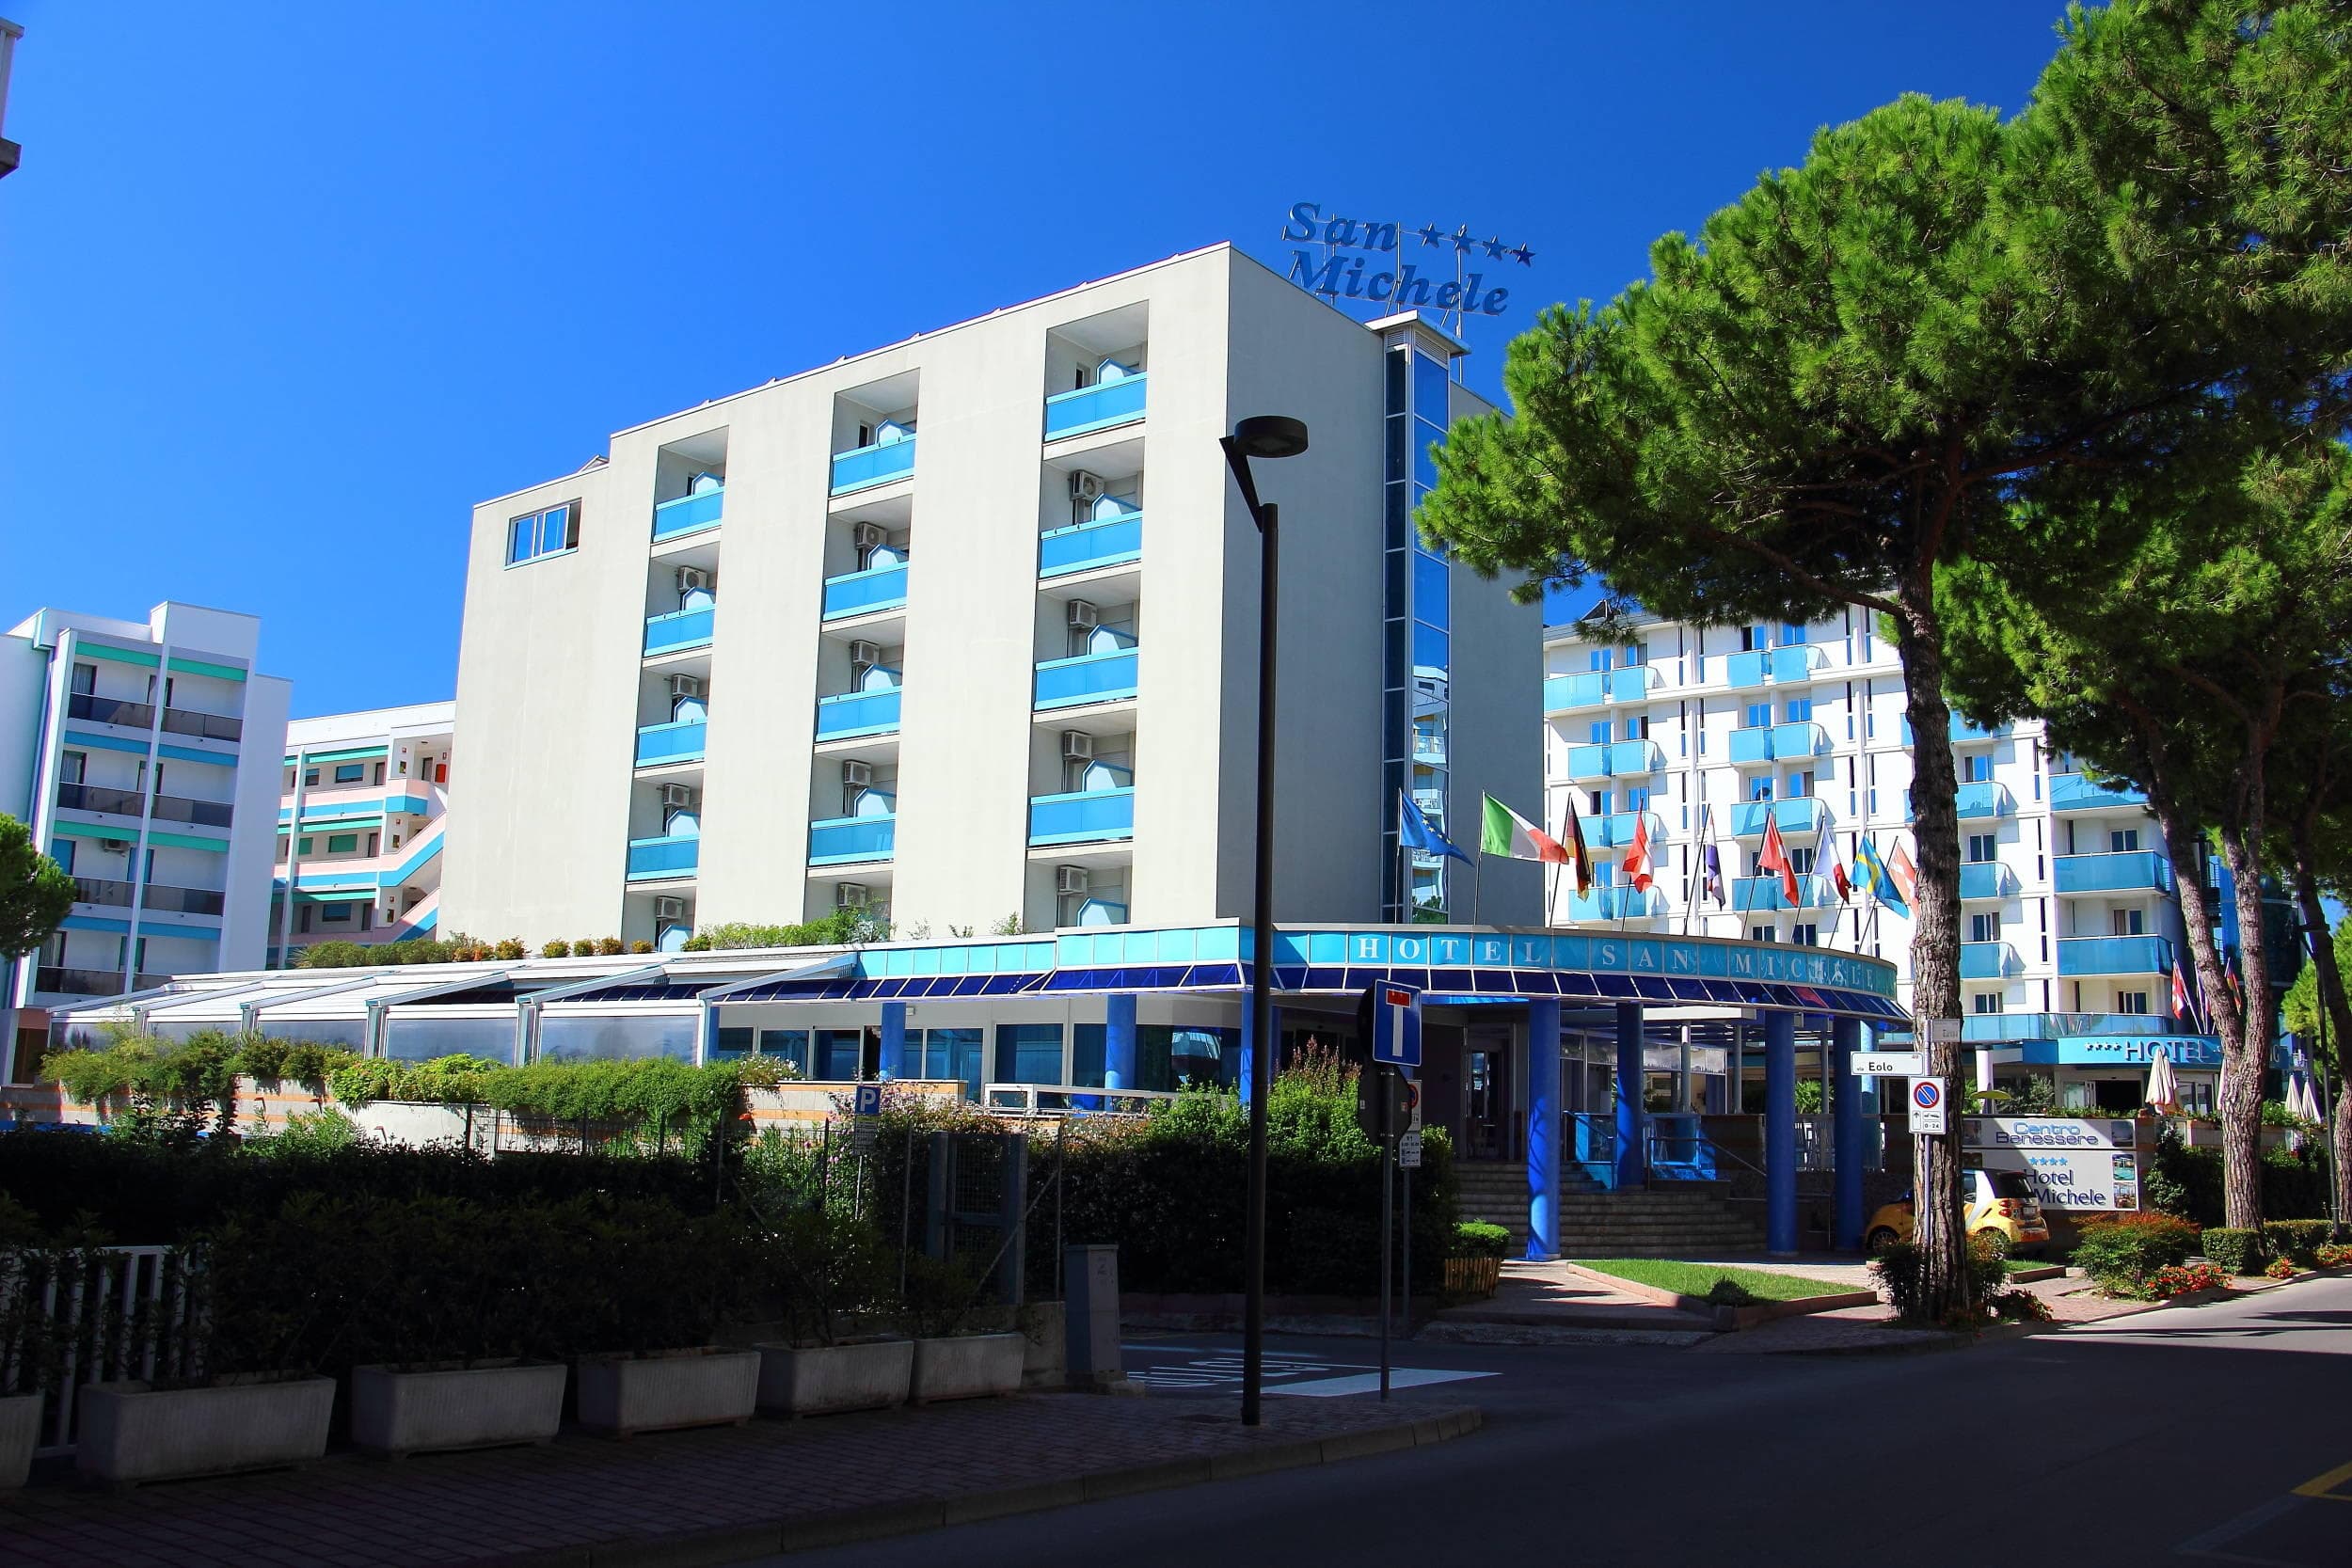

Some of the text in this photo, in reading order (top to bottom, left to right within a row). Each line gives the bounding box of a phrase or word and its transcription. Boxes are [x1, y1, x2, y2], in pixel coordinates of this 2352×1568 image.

[1282, 201, 1400, 252] San
[1288, 250, 1509, 316] Michele
[1359, 938, 1873, 989] HOTEL SAN MICHELE
[2124, 1038, 2211, 1062] HOTEL
[1868, 1062, 1893, 1071] Eolo
[860, 1089, 877, 1111] P
[2014, 1122, 2080, 1134] Centro
[1996, 1132, 2098, 1145] Benessere
[2024, 1168, 2074, 1186] Hotel
[2033, 1188, 2106, 1206] Michele
